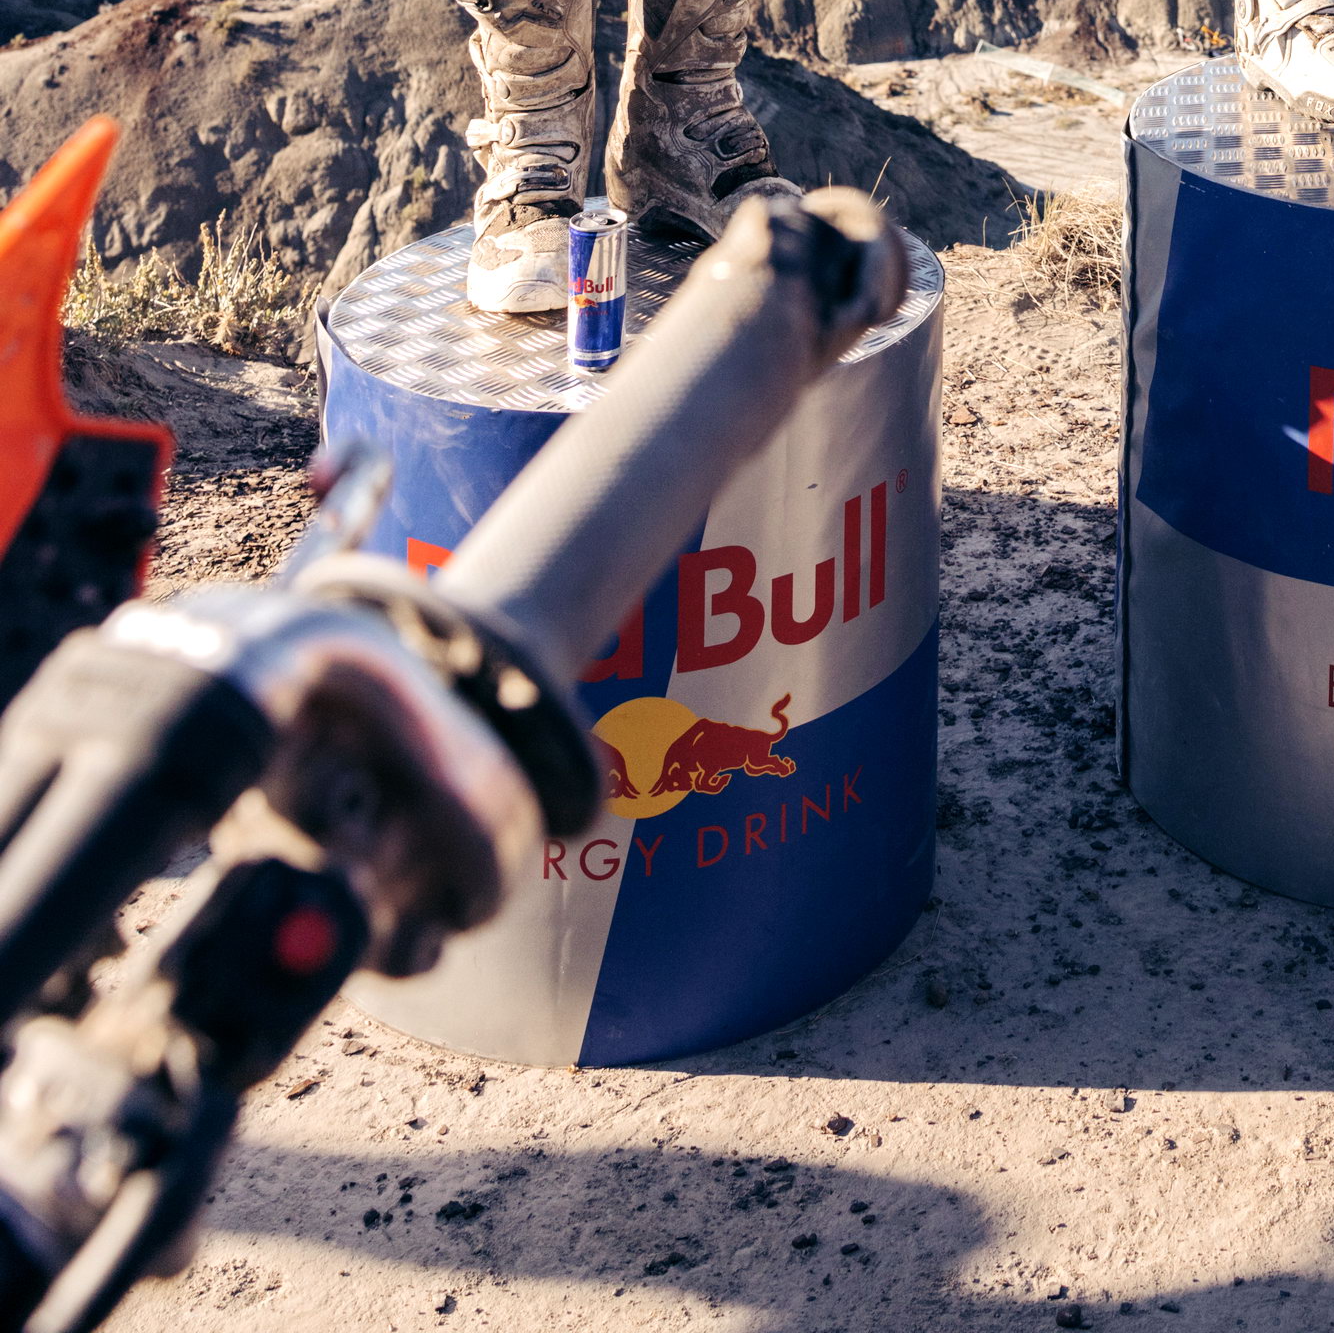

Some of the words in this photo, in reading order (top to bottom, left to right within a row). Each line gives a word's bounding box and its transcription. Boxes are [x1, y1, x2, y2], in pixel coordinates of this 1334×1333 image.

[584, 276, 614, 294] Bull
[676, 479, 888, 674] Bull
[543, 834, 666, 882] RGY
[697, 765, 863, 870] DRINK
